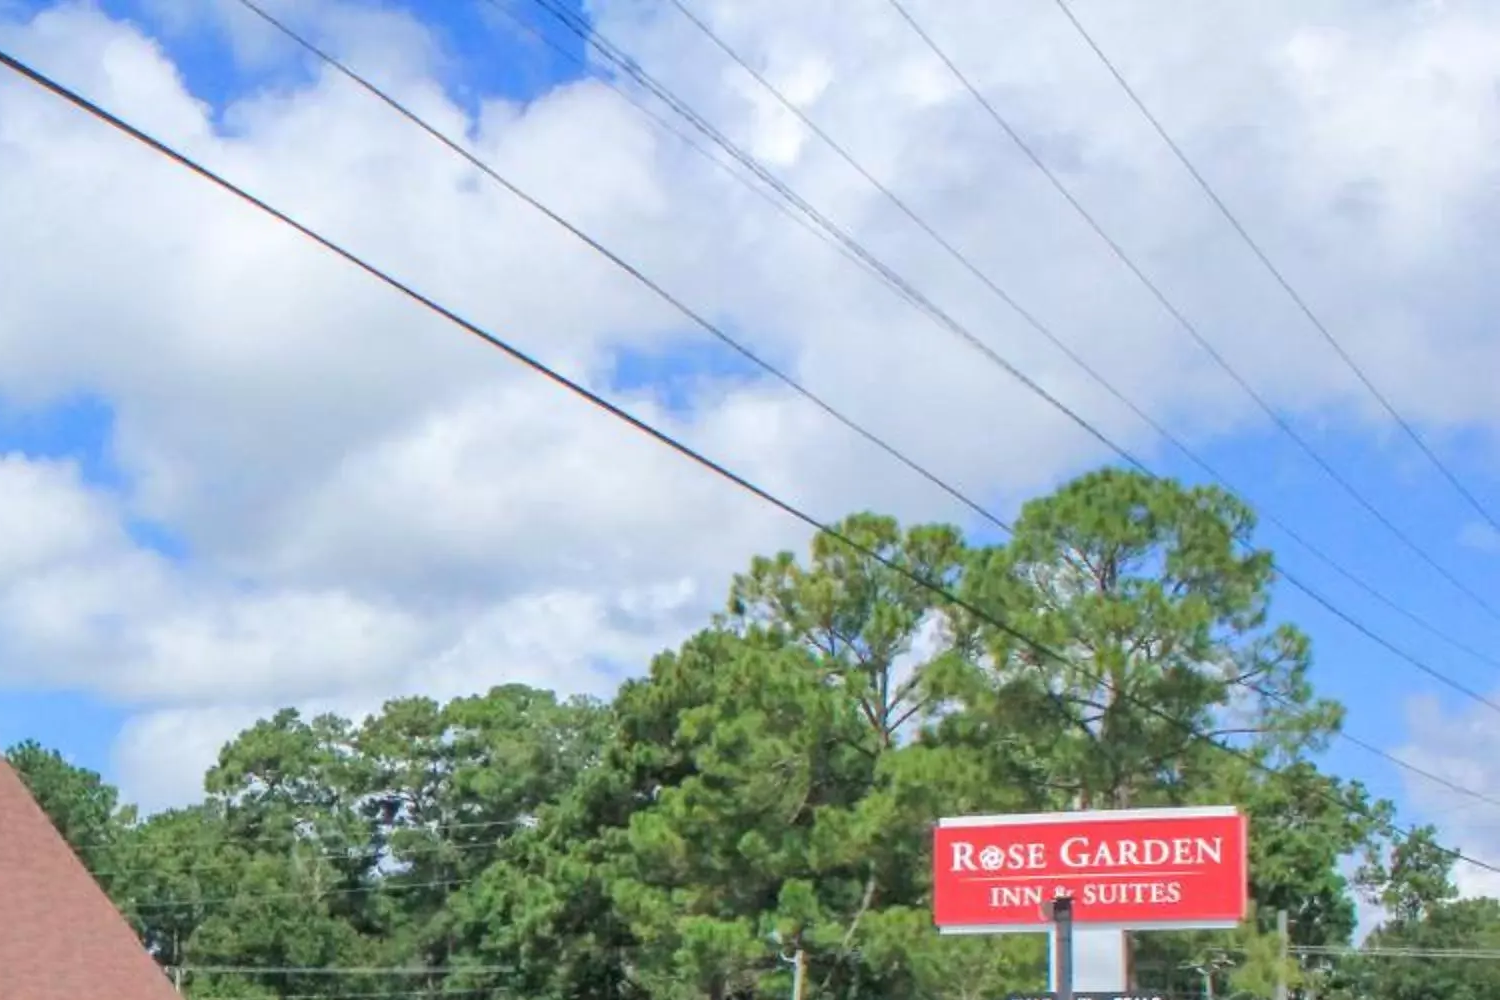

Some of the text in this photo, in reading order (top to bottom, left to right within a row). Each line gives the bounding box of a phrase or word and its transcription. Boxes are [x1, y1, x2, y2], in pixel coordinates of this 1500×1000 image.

[950, 836, 1223, 873] ROSE GARDEN
[990, 885, 1043, 907] INN
[1082, 881, 1182, 905] SUITES
